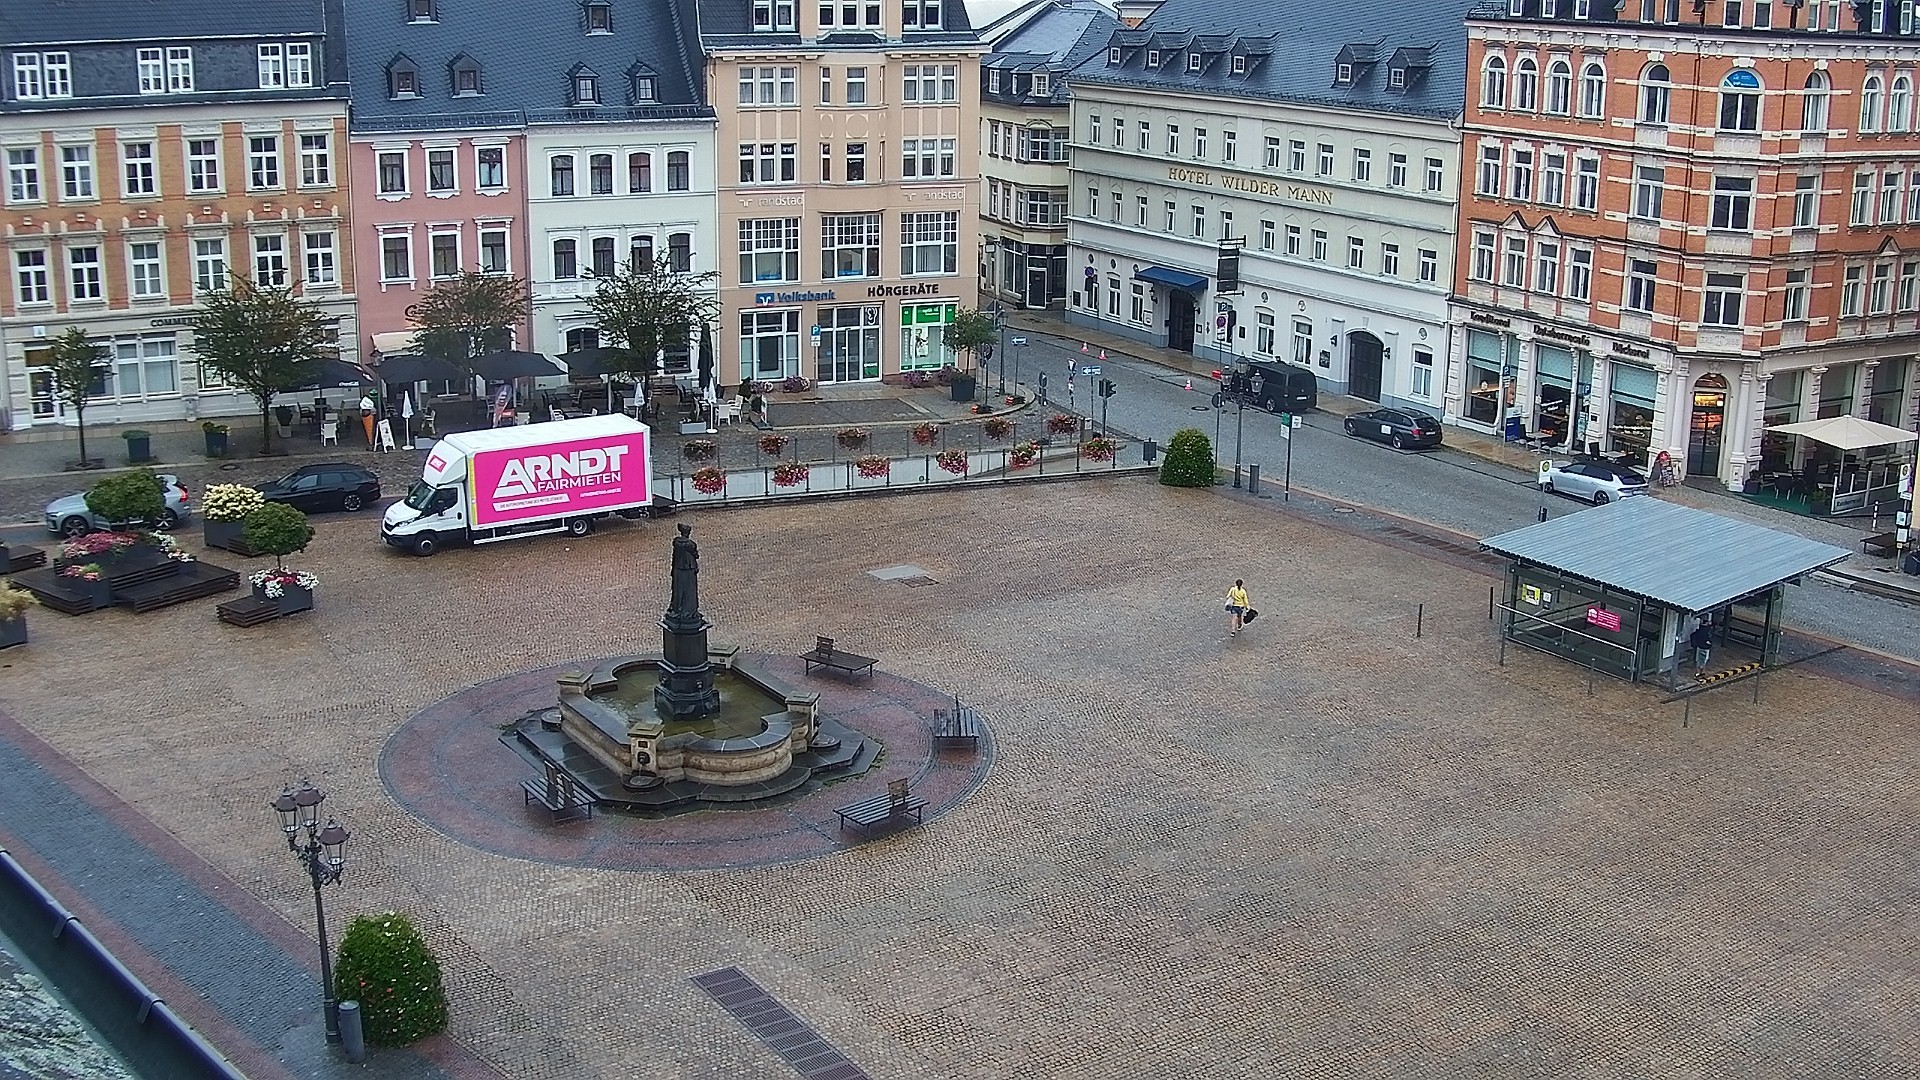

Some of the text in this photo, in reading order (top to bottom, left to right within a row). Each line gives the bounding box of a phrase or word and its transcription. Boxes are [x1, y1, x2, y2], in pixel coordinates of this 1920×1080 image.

[1168, 167, 1334, 205] HOTEL WILDER MANN
[758, 193, 804, 207] randstad
[777, 289, 836, 303] Volksbank
[867, 283, 939, 298] HÖRGERÄTE
[492, 445, 629, 499] ARNDT
[537, 472, 622, 493] FAIRMIETEN
